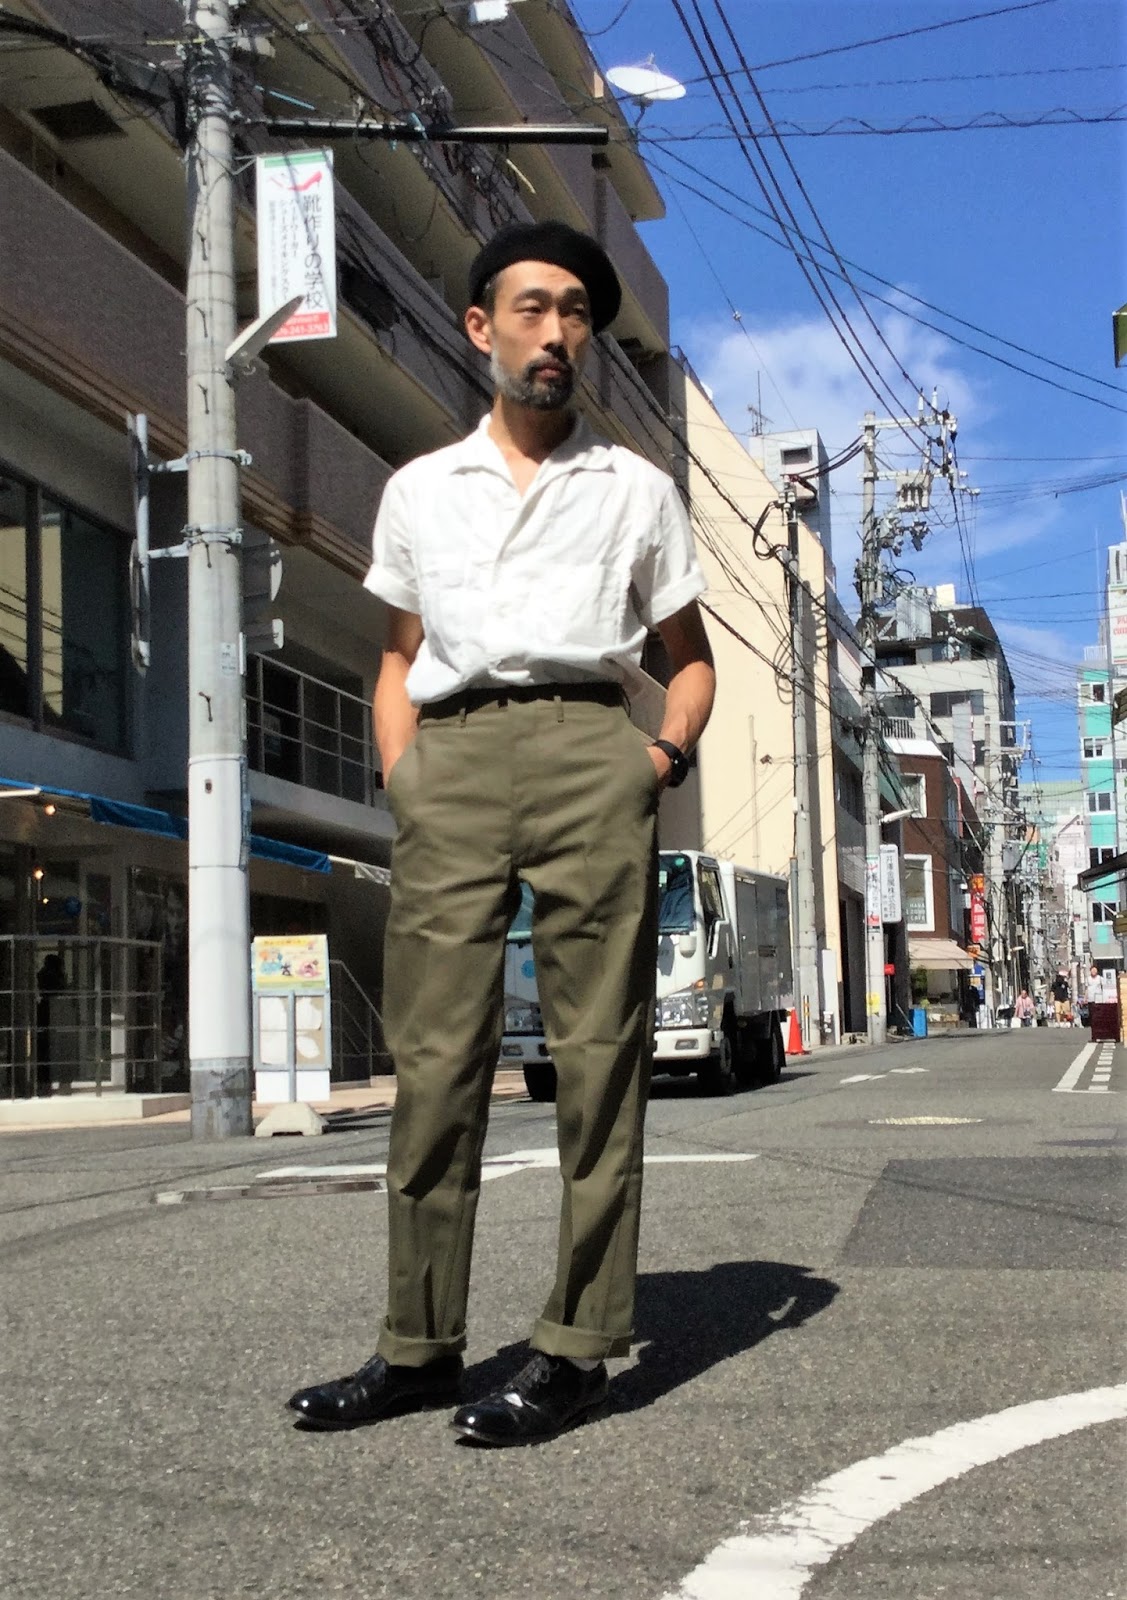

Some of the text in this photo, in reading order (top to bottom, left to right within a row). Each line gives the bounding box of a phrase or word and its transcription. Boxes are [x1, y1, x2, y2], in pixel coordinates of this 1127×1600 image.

[279, 199, 290, 304] シューズメイキングスクー
[303, 195, 323, 310] 靴作りの学校
